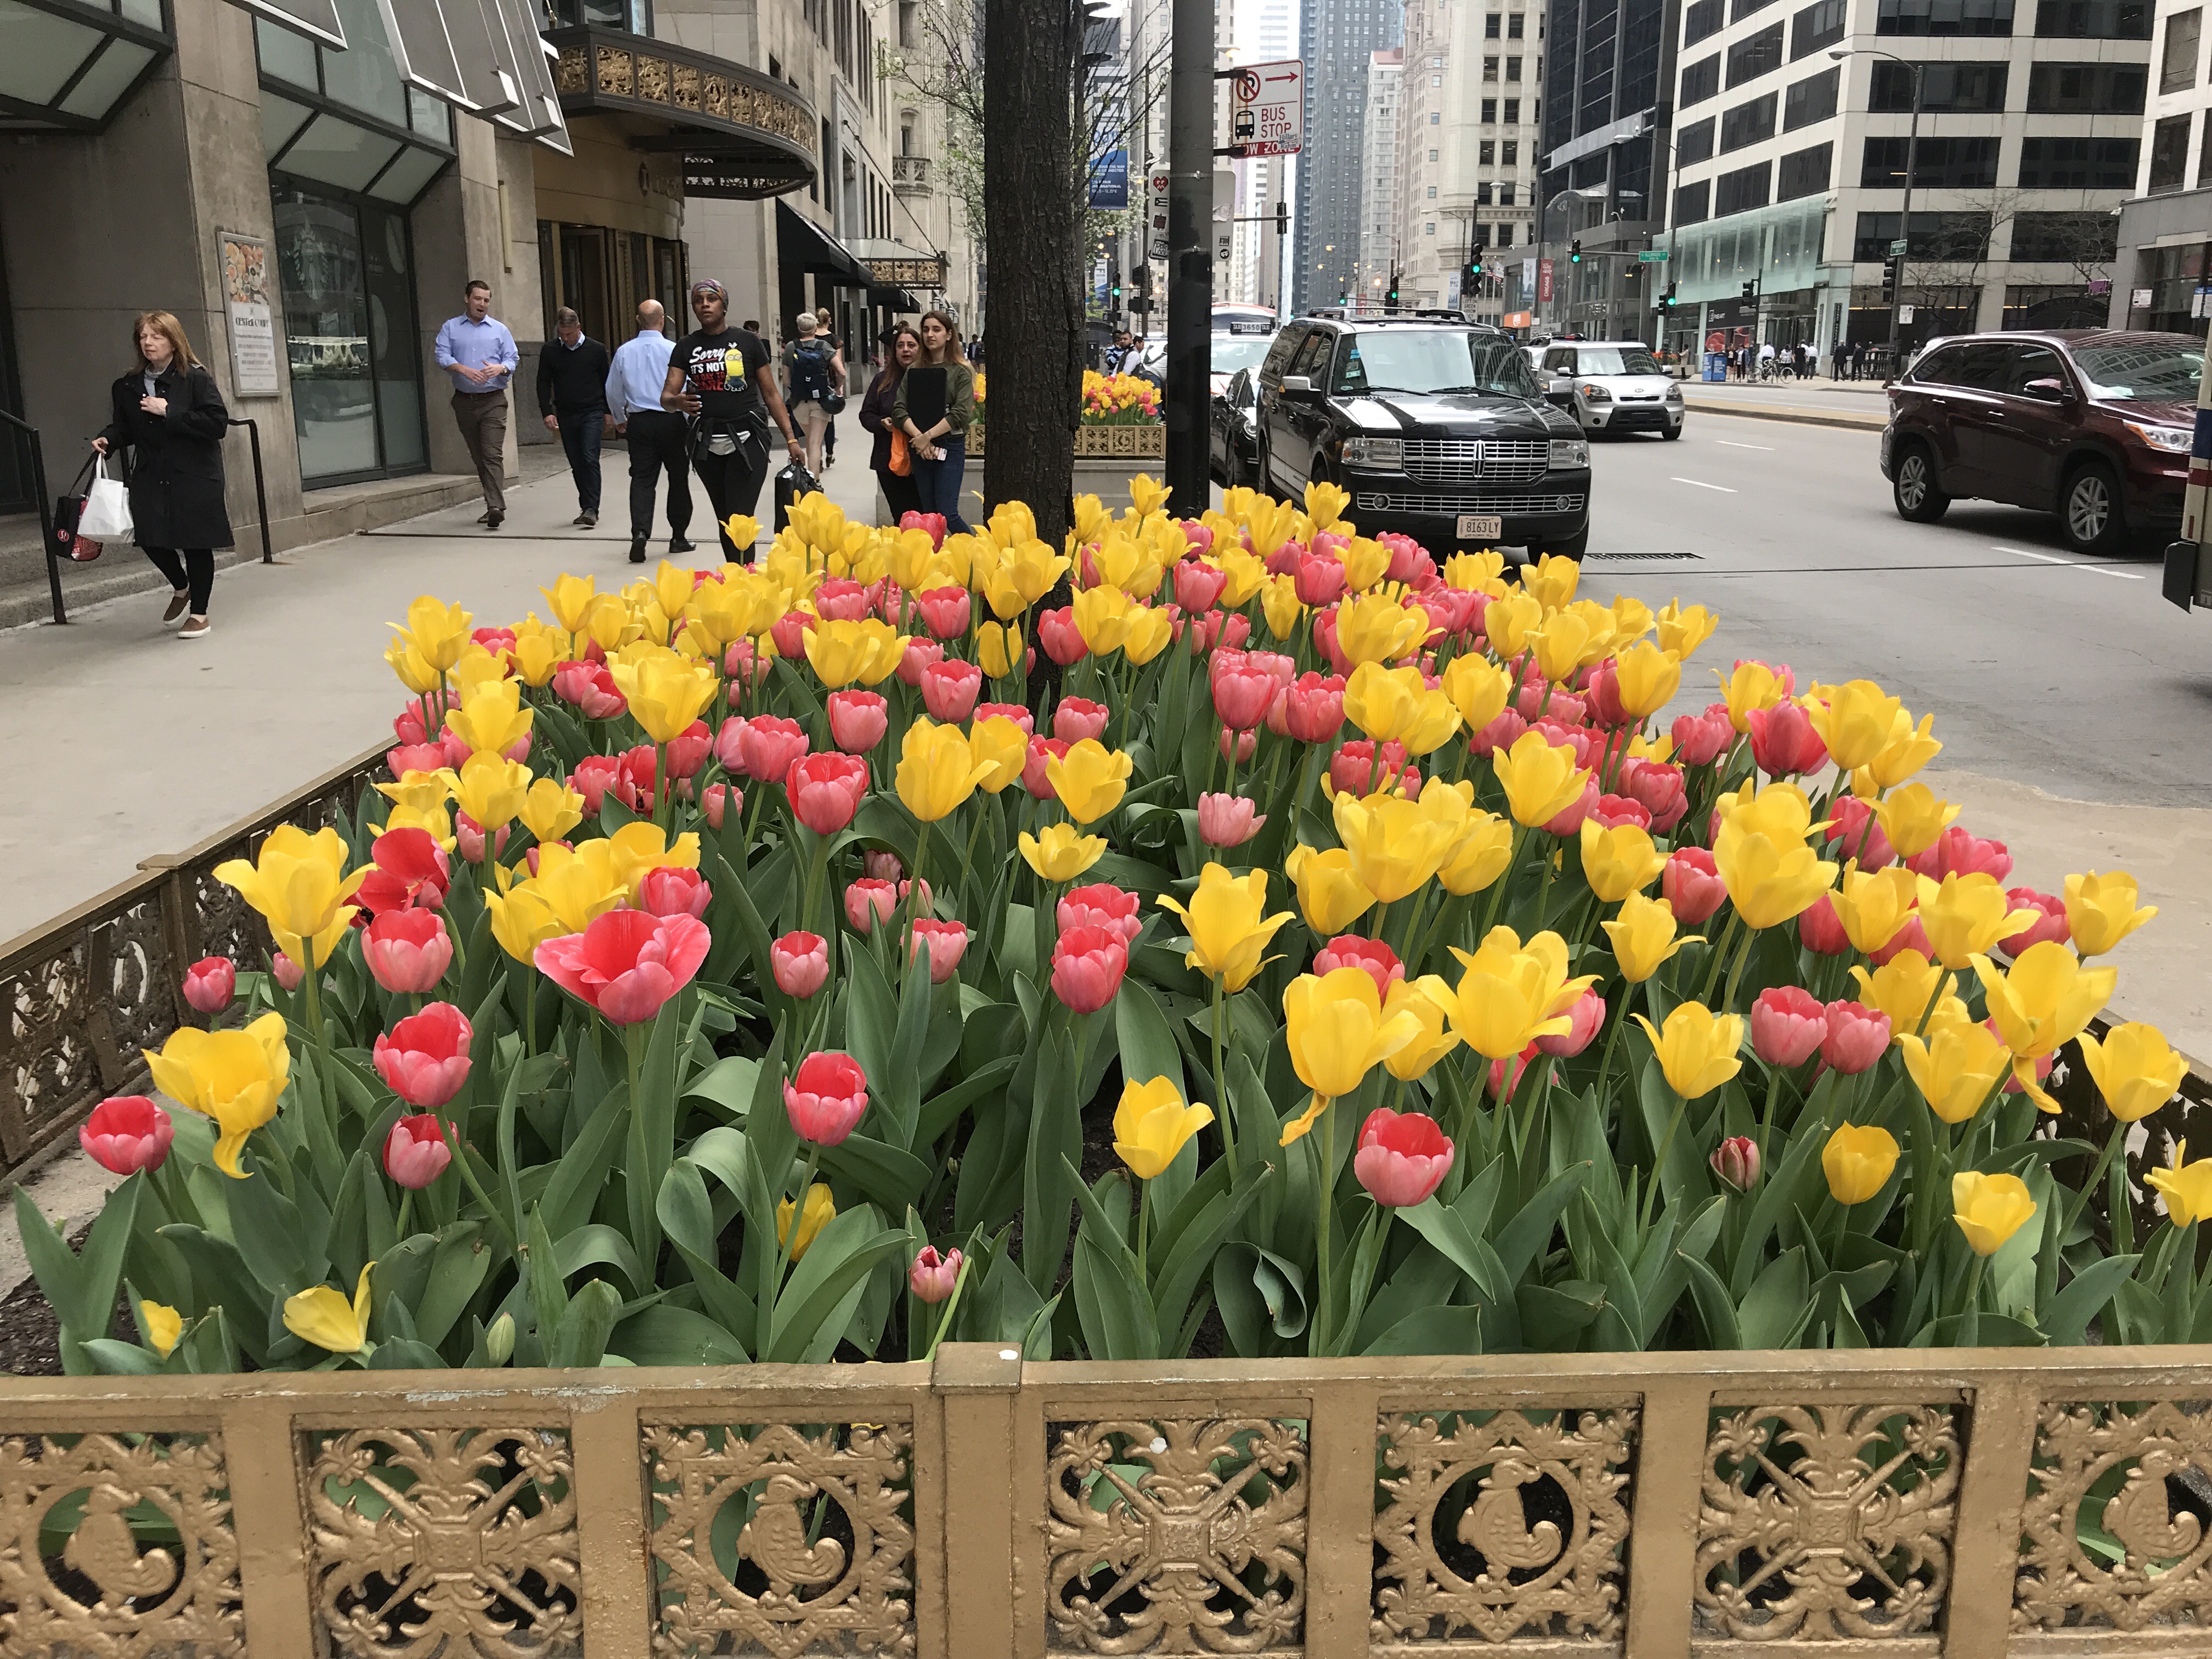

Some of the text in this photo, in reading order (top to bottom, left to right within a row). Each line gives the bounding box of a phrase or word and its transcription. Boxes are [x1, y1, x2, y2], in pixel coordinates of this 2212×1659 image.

[1261, 106, 1286, 122] BUS
[1261, 122, 1292, 138] STOP
[1279, 133, 1298, 141] Hillary
[1235, 143, 1259, 155] OW
[689, 346, 726, 363] Sorry
[690, 362, 725, 374] IT'S NOT
[1466, 521, 1487, 533] 8163
